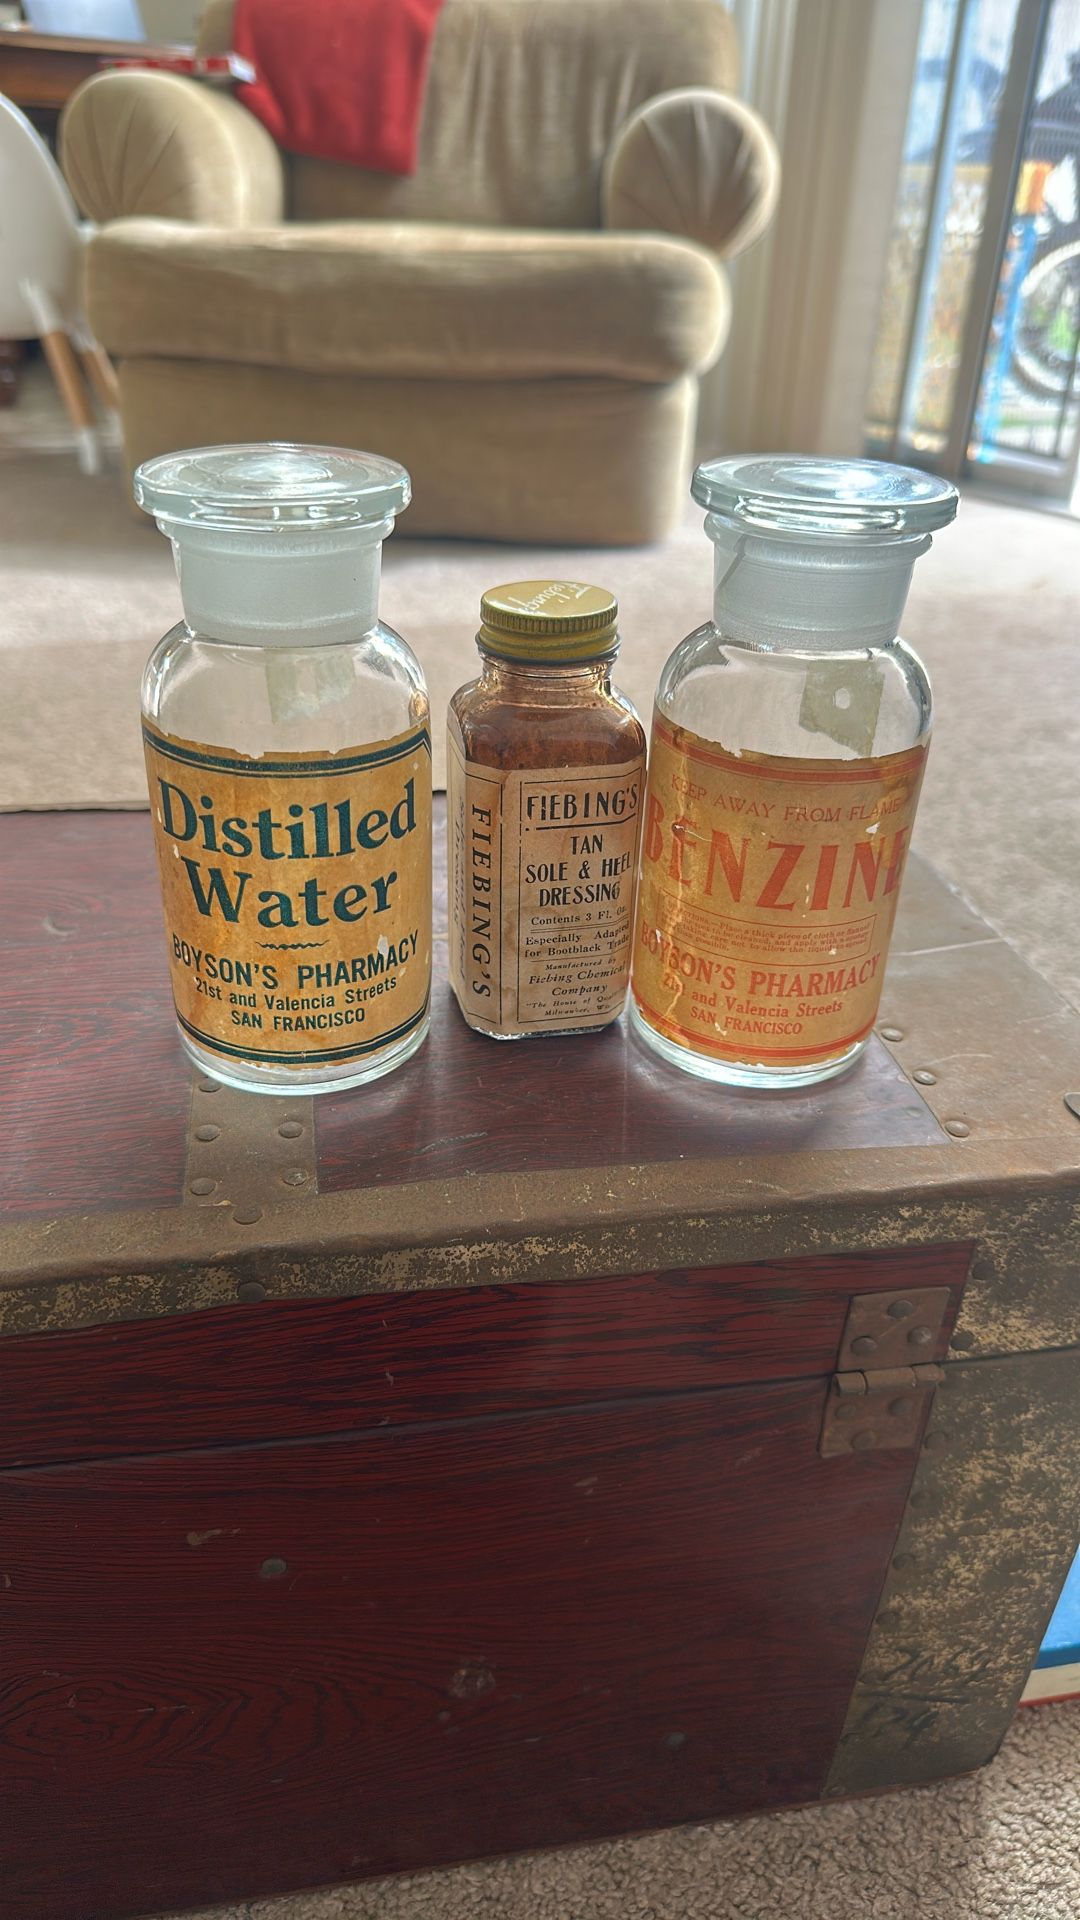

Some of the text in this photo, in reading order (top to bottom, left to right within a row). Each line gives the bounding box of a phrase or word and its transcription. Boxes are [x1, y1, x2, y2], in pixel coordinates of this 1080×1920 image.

[526, 783, 638, 821] FIEBING'S
[672, 774, 707, 800] KEEP
[713, 794, 775, 818] AWAY
[783, 805, 842, 822] FROM
[157, 776, 416, 860] Distilled
[570, 834, 603, 855] TAN
[525, 852, 631, 884] SOLE & HEEL
[181, 855, 398, 928] Water
[471, 804, 491, 998] FIEBING'S
[540, 882, 620, 907] DRESSING
[531, 914, 580, 926] Contents
[585, 912, 592, 921] 3
[525, 949, 541, 958] for
[548, 943, 601, 956] Bootblack
[526, 933, 582, 946] Especially
[172, 929, 419, 990] BOYSON'S PHARMACY
[529, 960, 626, 985] Fiebing Chemical
[641, 919, 881, 998] BOYSON'S PHARMACY
[196, 977, 397, 1011] 21st and Valencia Streets
[552, 984, 608, 996] Company
[231, 1007, 366, 1032] SAN FRANCISCO
[691, 992, 717, 1008] and
[725, 996, 789, 1019] Valencia
[796, 1000, 843, 1018] Streets
[690, 1006, 803, 1036] SAN FRANCISCO
